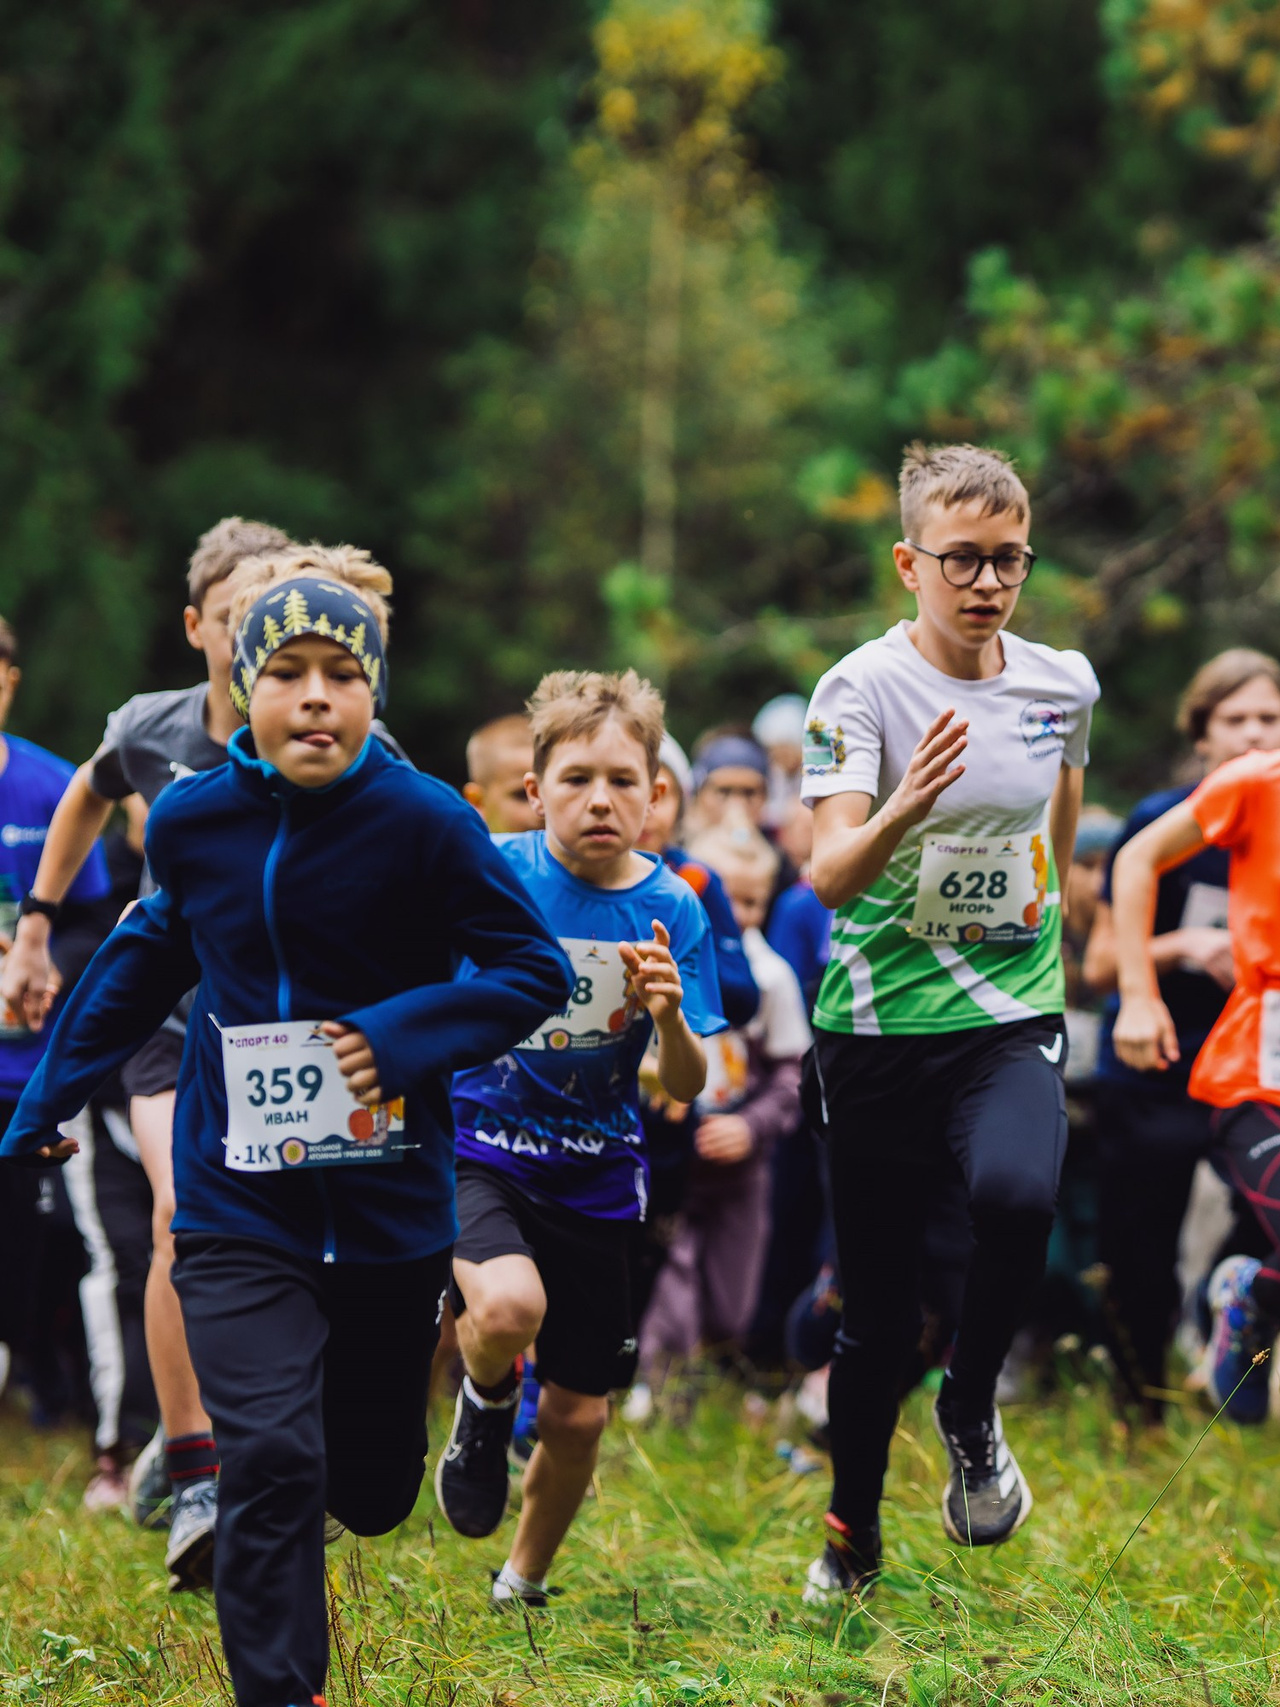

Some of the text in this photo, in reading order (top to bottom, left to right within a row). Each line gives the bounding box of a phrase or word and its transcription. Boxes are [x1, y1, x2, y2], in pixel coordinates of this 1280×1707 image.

[939, 870, 1008, 899] 628
[949, 901, 995, 914] ИГОРЬ
[235, 1035, 269, 1048] СПОРТ
[272, 1034, 288, 1045] 40
[246, 1064, 324, 1107] 359
[264, 1110, 309, 1126] ИВАН
